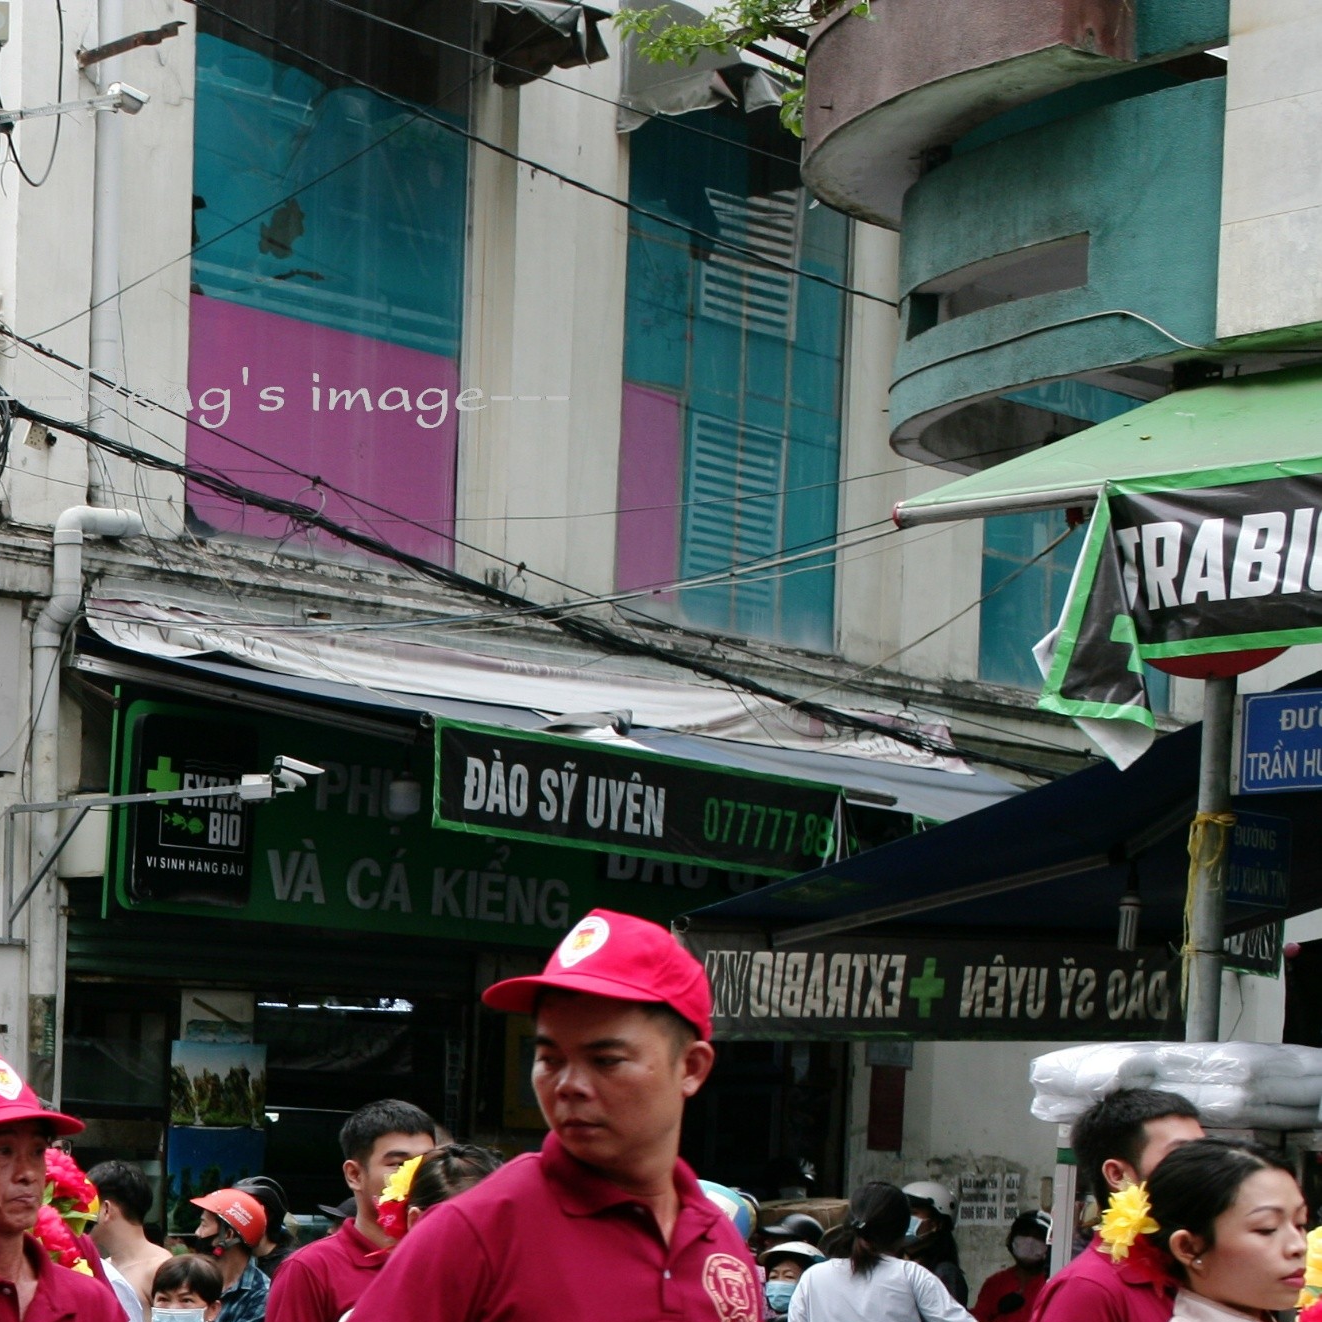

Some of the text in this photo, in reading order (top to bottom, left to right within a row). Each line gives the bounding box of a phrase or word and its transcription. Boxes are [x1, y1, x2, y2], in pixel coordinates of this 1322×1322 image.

[1247, 739, 1296, 781] TRẦN
[463, 748, 528, 818] ĐÀO
[539, 761, 577, 824] SỸ
[585, 771, 666, 838] UYÊN
[703, 796, 798, 854] 077777
[208, 811, 242, 847] BIO
[145, 855, 157, 868] VI
[160, 857, 185, 871] SINH
[267, 839, 326, 905] VÀ
[346, 838, 413, 913] CÁ
[430, 844, 572, 930] KIỂNG
